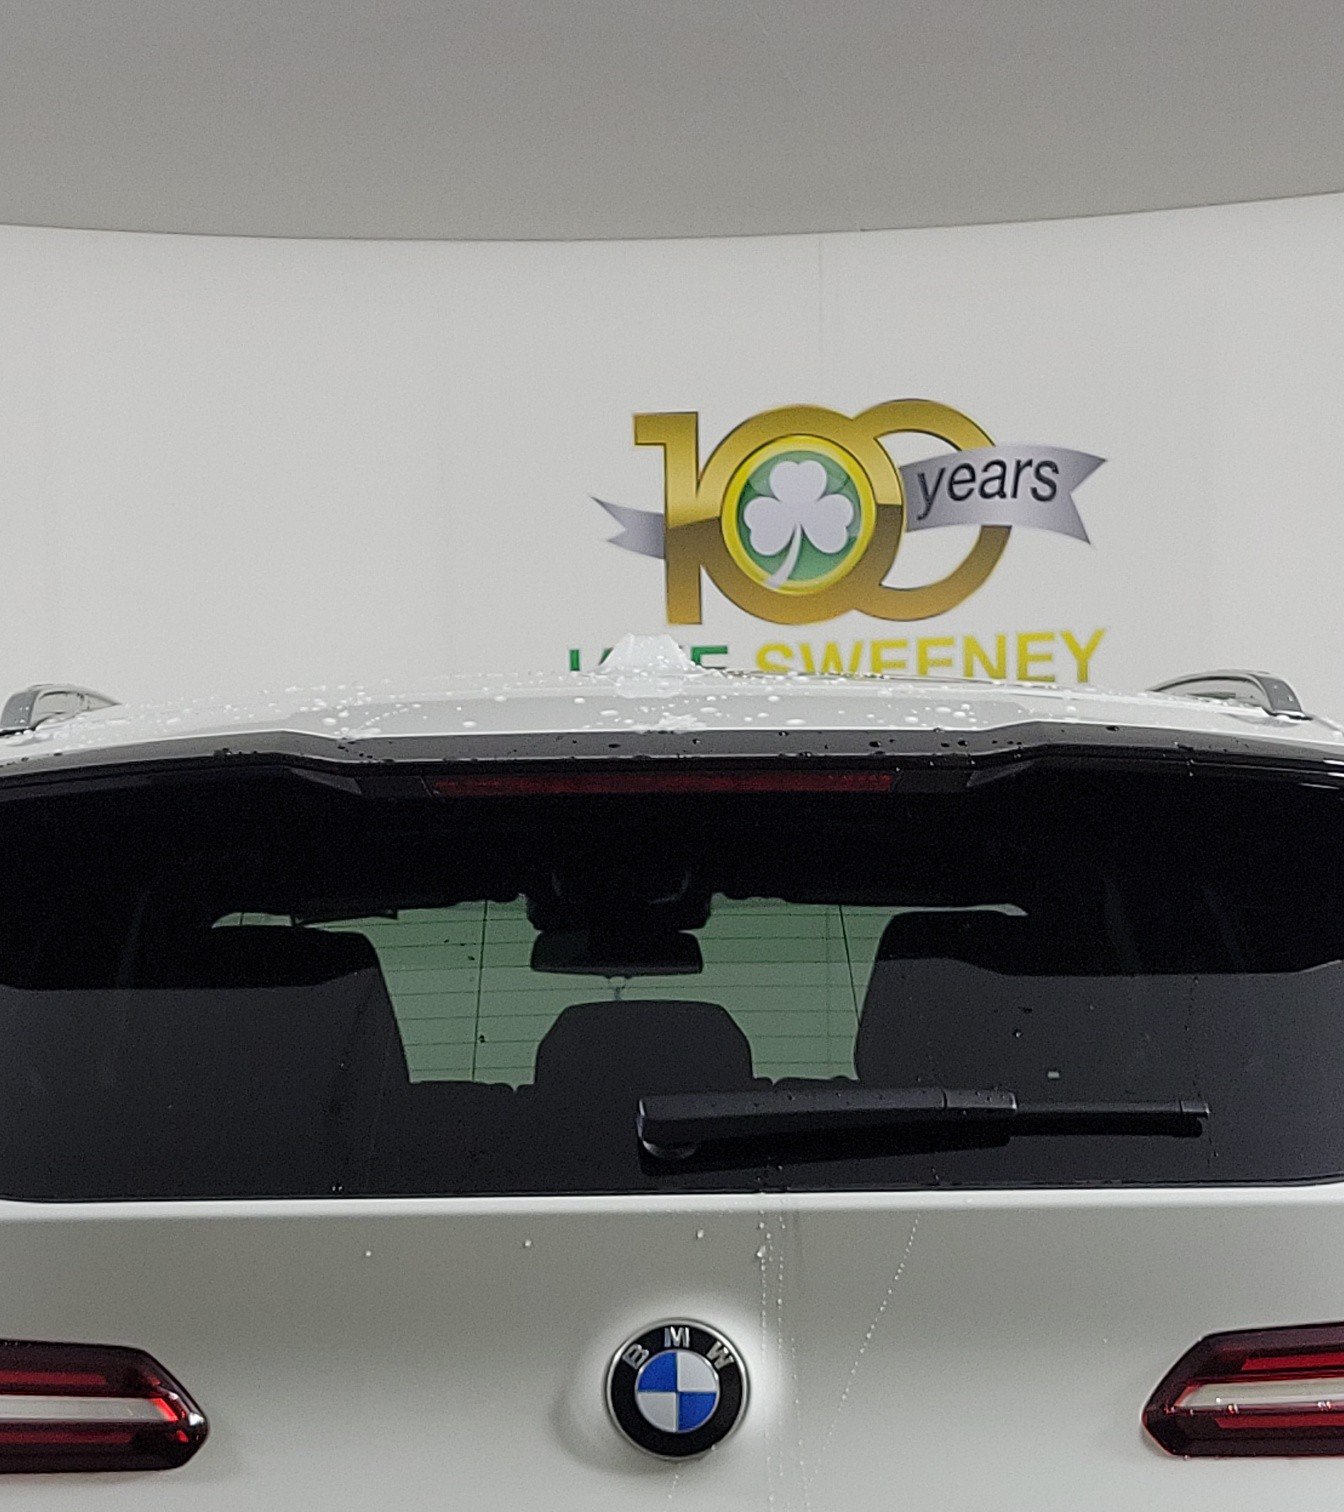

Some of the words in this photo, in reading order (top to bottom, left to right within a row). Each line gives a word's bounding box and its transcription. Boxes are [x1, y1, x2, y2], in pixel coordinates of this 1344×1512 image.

[633, 398, 1012, 626] 100
[917, 455, 1061, 521] years
[622, 1326, 735, 1370] BMW
